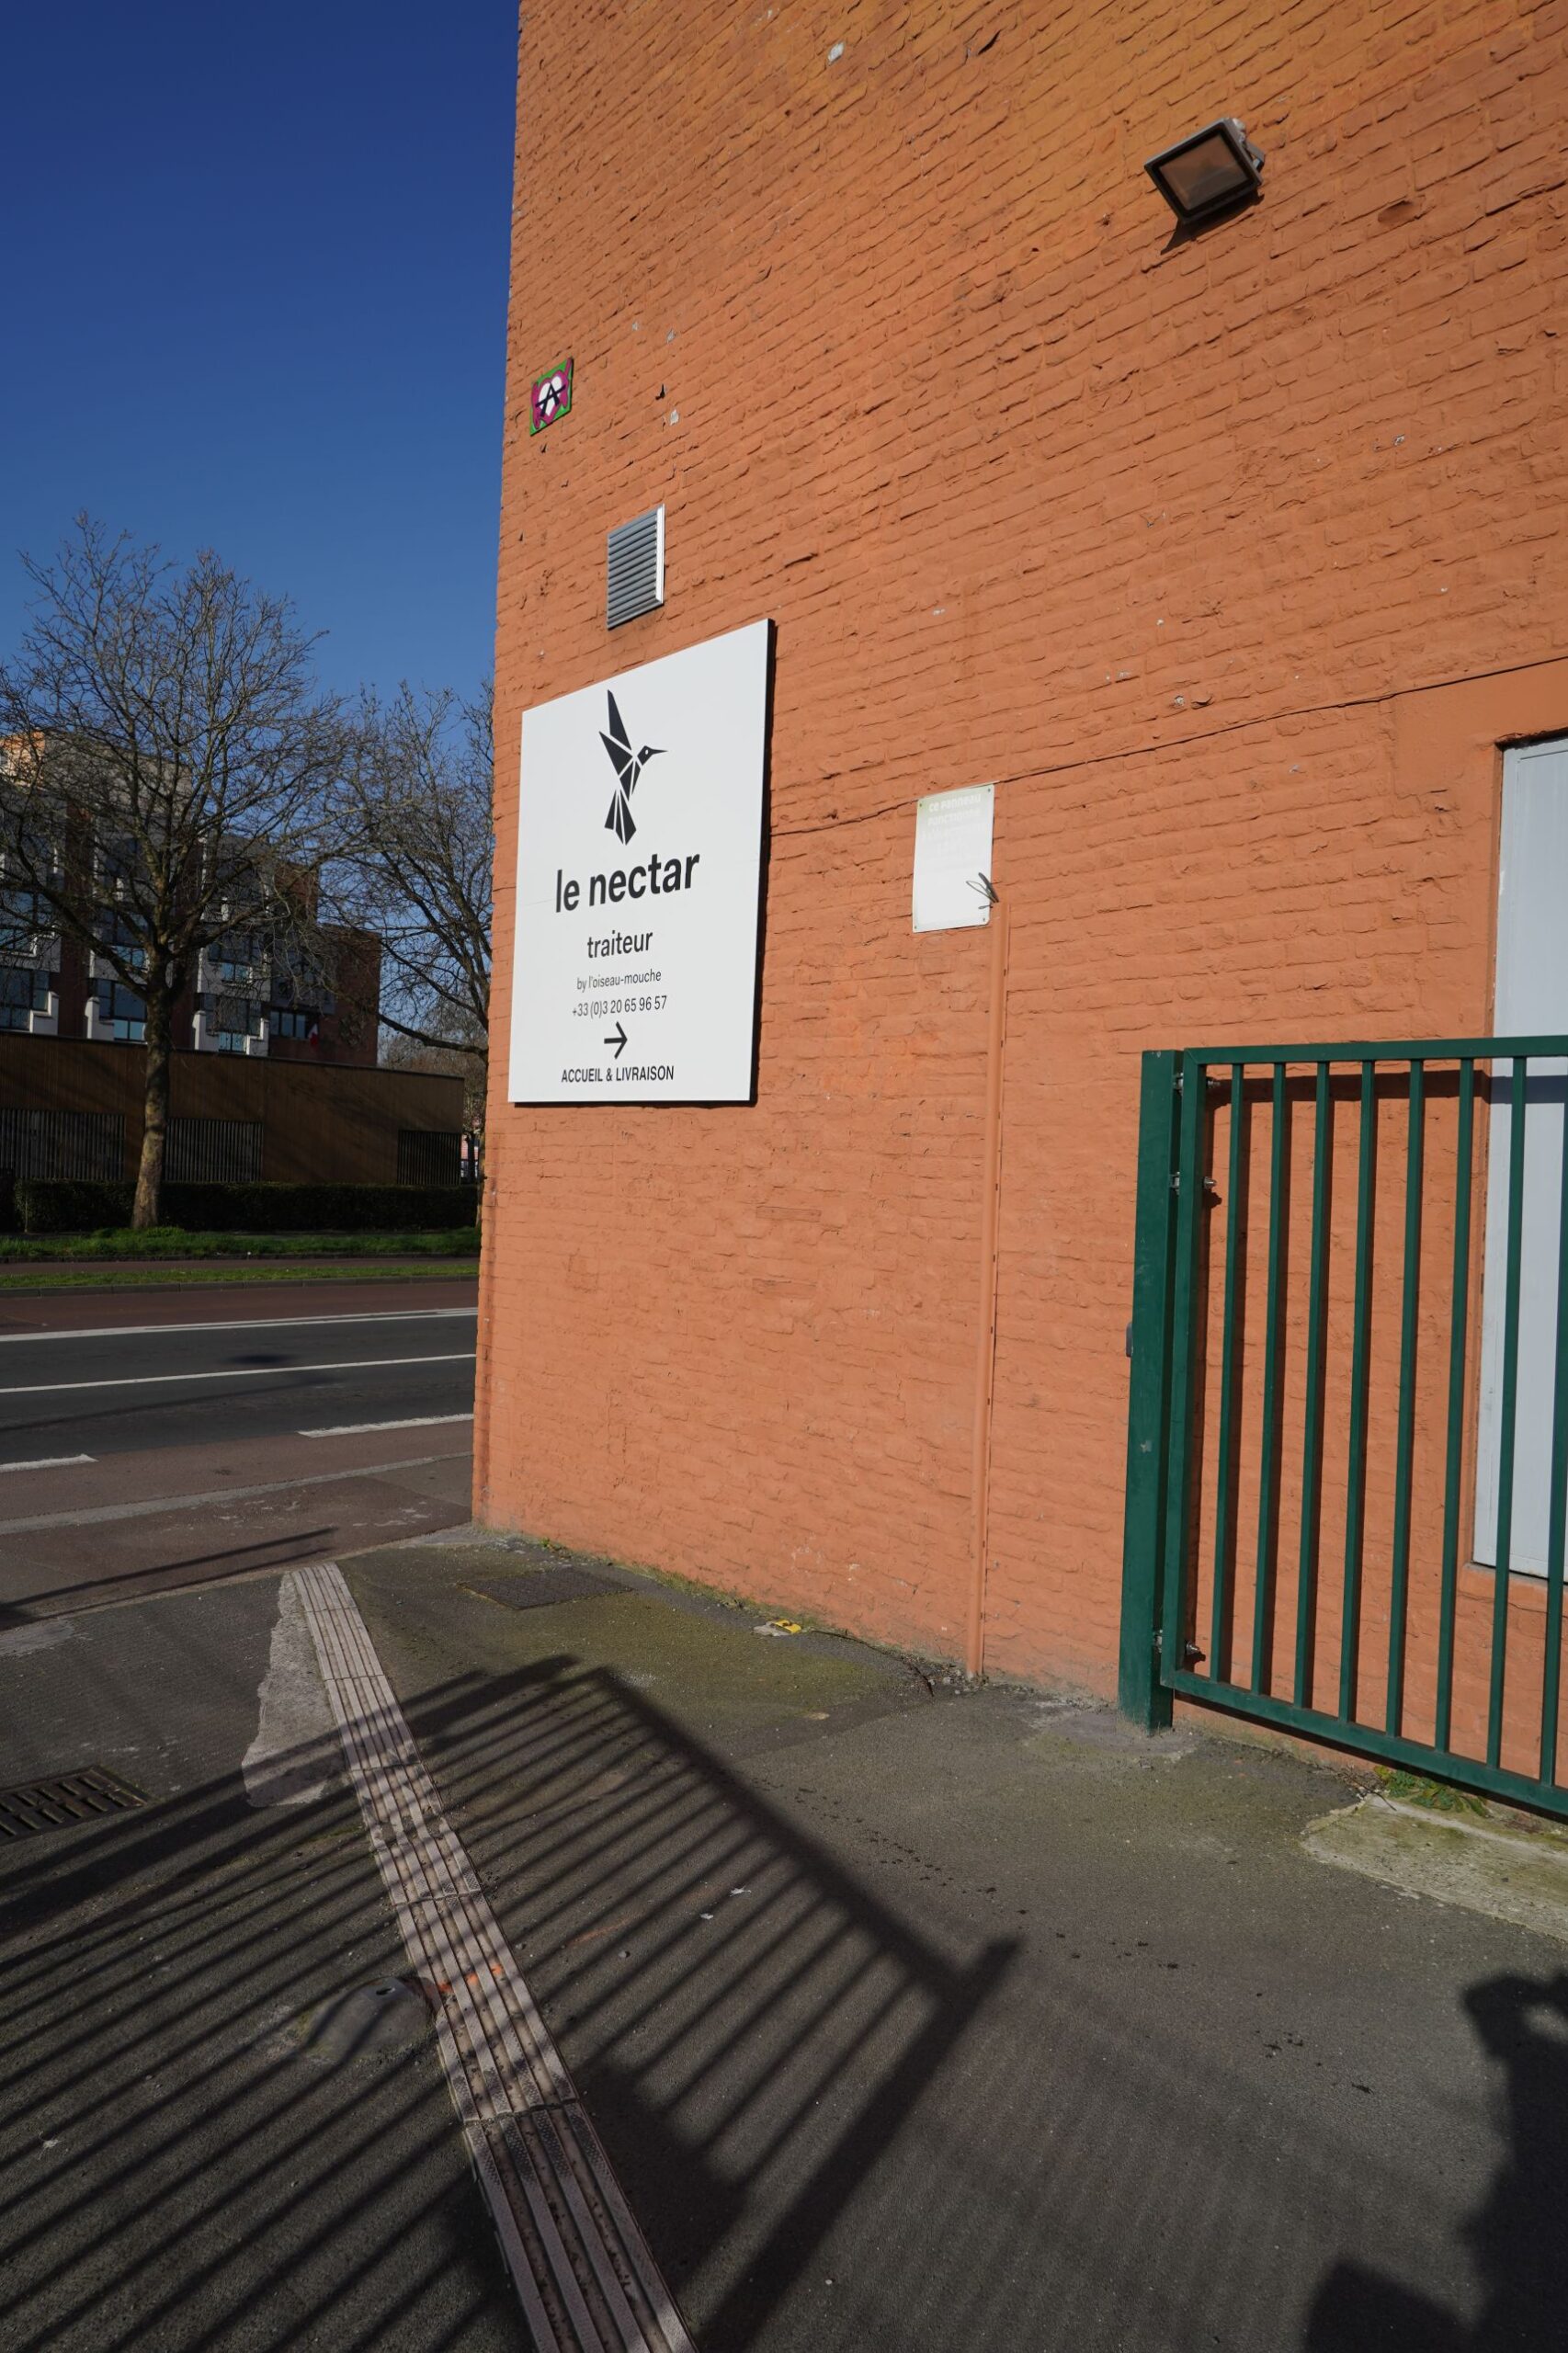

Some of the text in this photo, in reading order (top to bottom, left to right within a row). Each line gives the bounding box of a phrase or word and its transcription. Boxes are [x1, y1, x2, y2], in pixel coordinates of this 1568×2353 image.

[555, 853, 700, 913] le nectar
[587, 929, 653, 959] traiteur
[576, 968, 662, 993] by l'oiseau-mouche
[572, 995, 667, 1019] +33 (0)3 20 65 96 57
[561, 1065, 675, 1083] ACCUEIL & LIVRAISON
